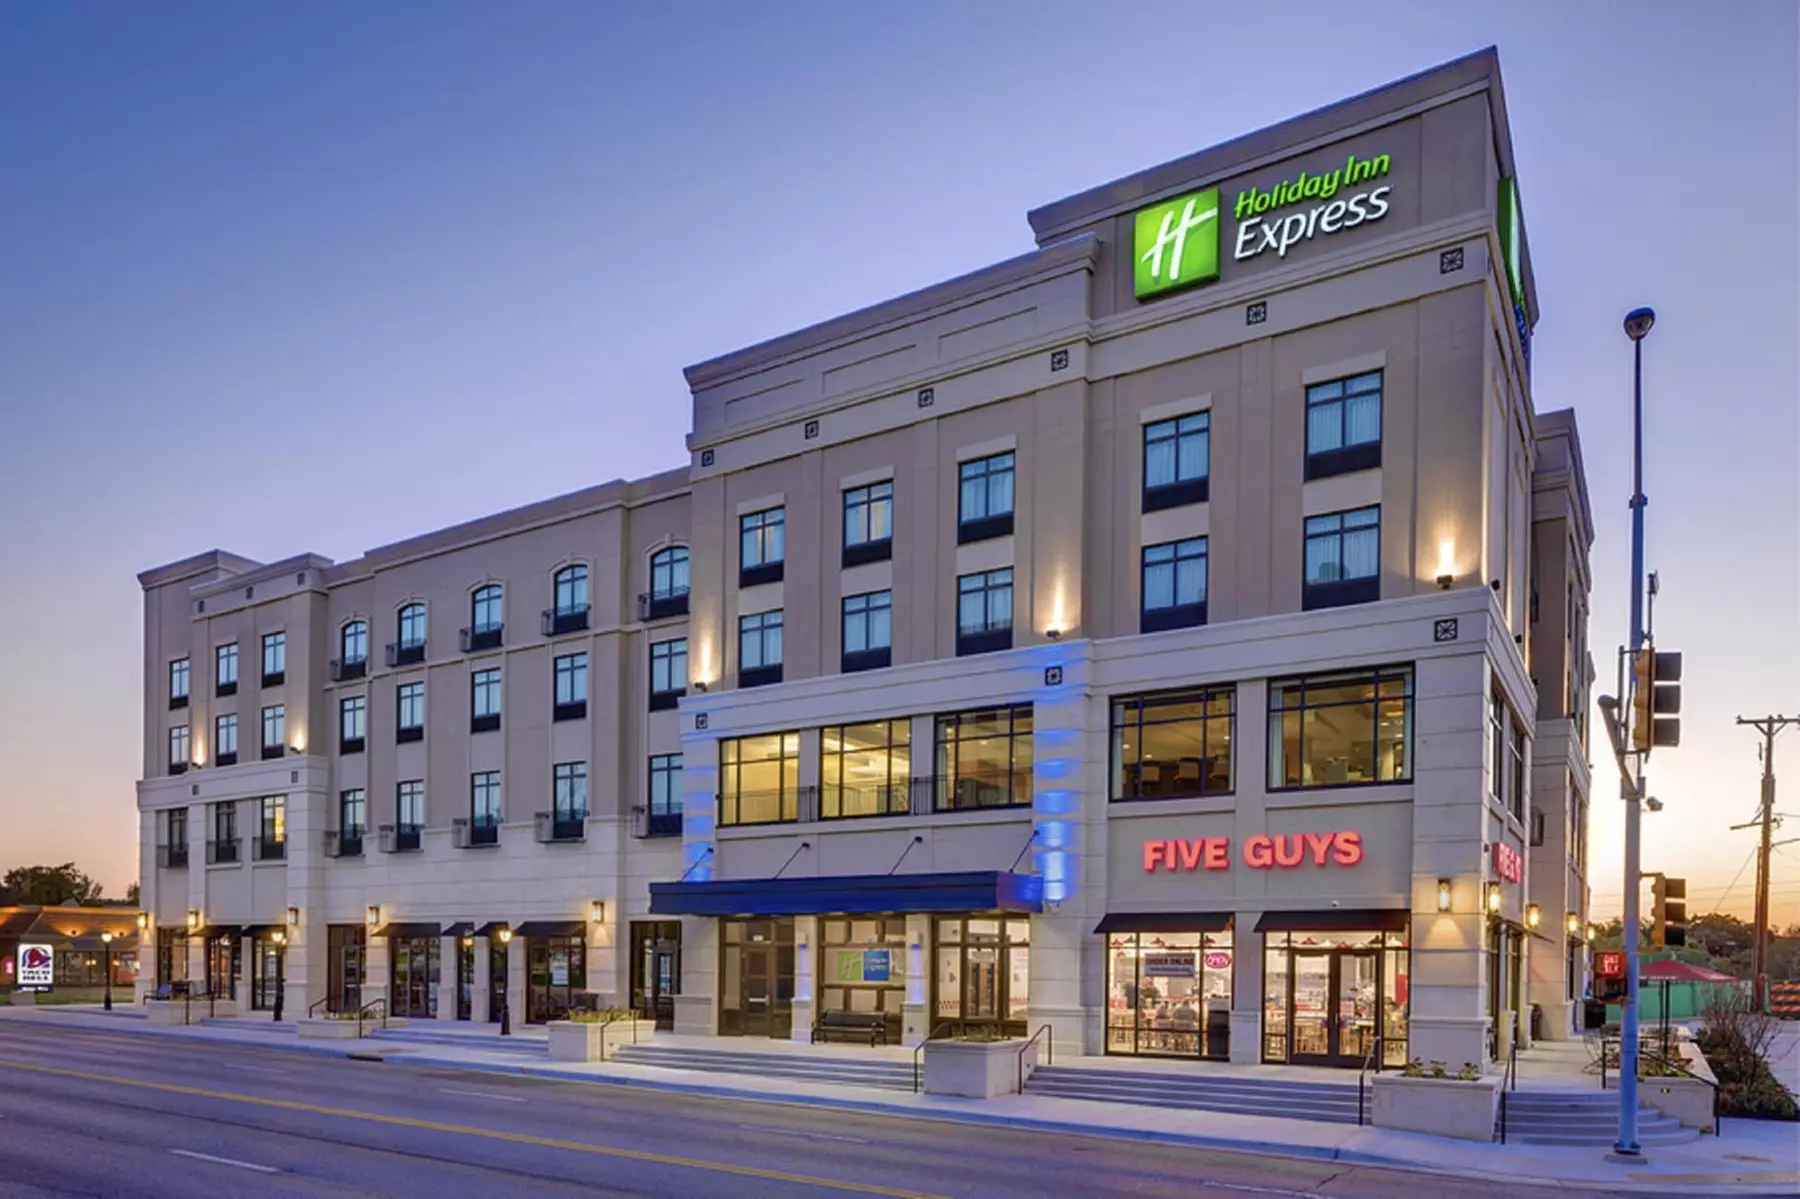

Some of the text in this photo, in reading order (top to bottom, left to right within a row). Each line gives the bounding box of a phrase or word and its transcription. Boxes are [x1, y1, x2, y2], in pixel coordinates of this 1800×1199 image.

[1234, 153, 1391, 220] Holiday Inn
[1234, 185, 1393, 260] Express
[1143, 830, 1364, 873] FIVE GUYS
